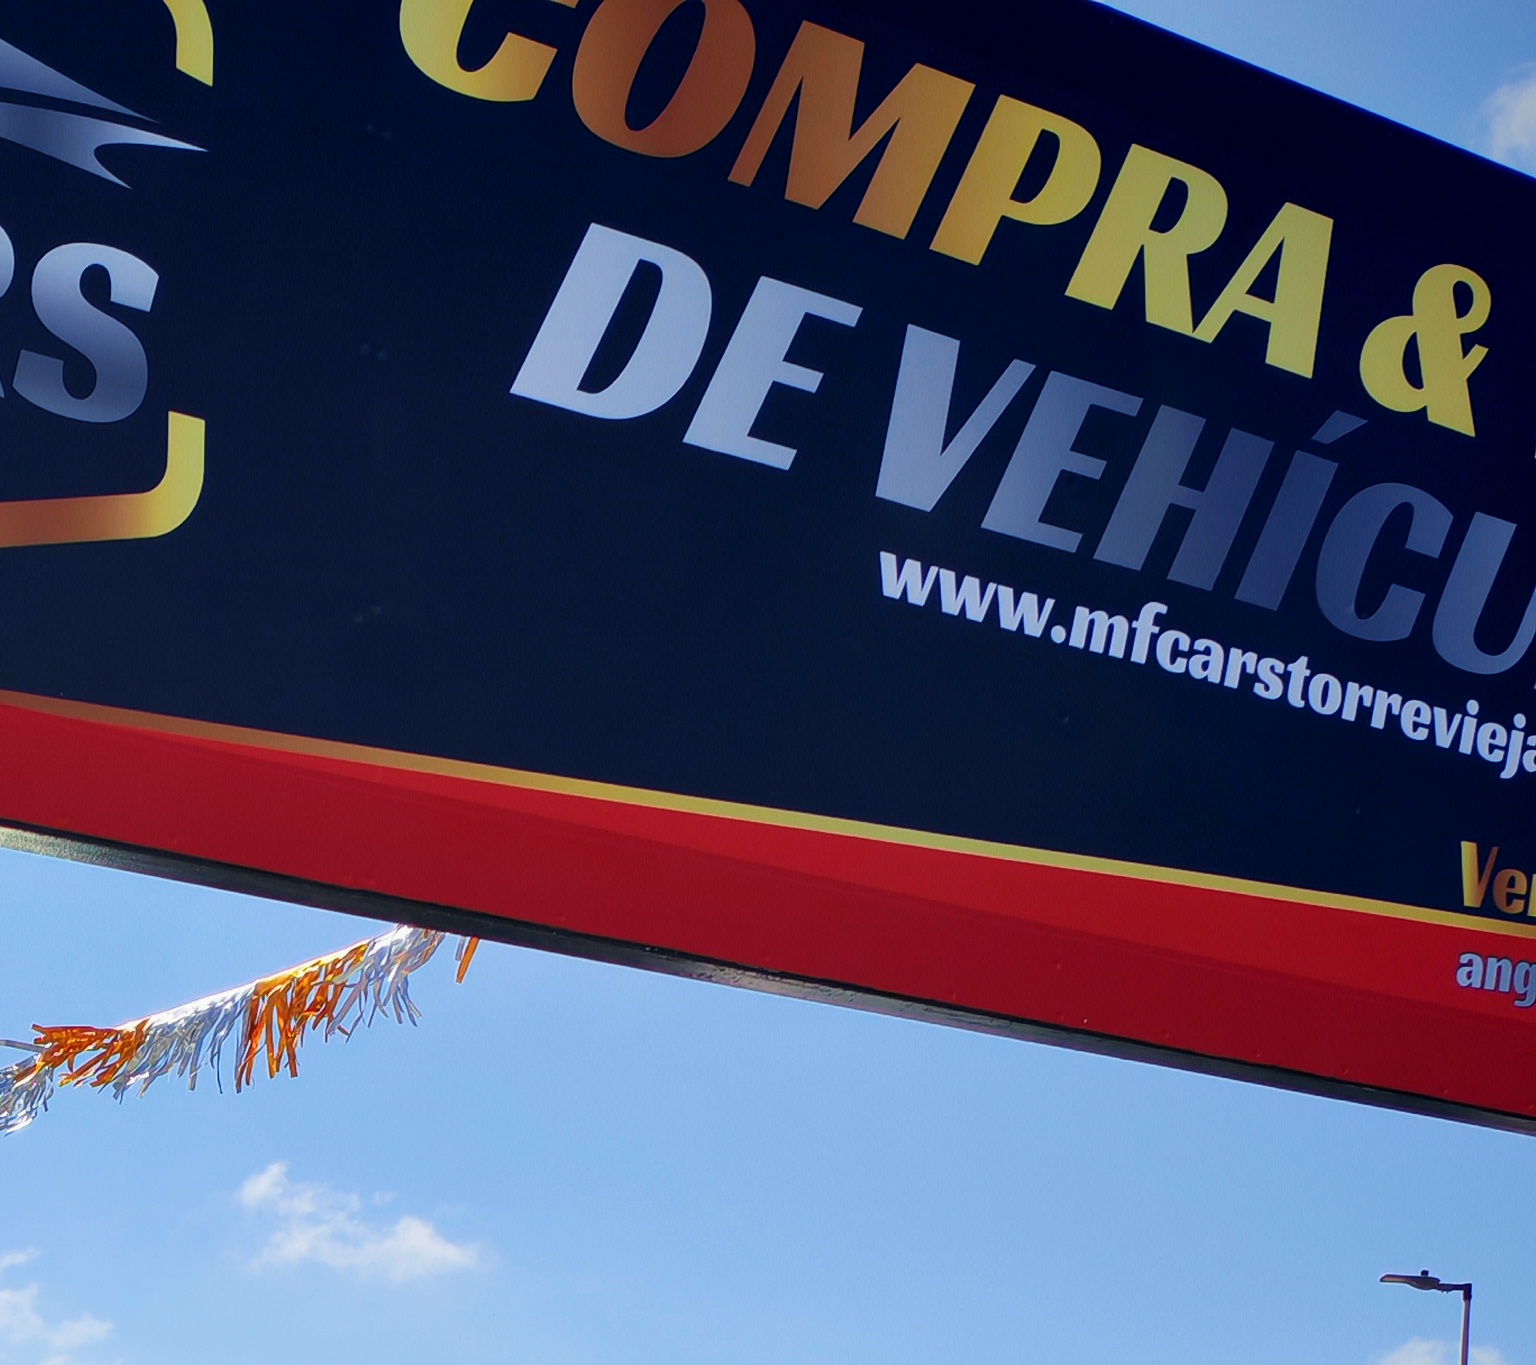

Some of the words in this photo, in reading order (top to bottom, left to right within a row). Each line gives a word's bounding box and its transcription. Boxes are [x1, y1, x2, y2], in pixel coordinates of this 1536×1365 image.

[398, 0, 1335, 379] COMPRA
[1360, 264, 1492, 437] &
[510, 223, 863, 471] DE
[1461, 841, 1536, 917] Ve
